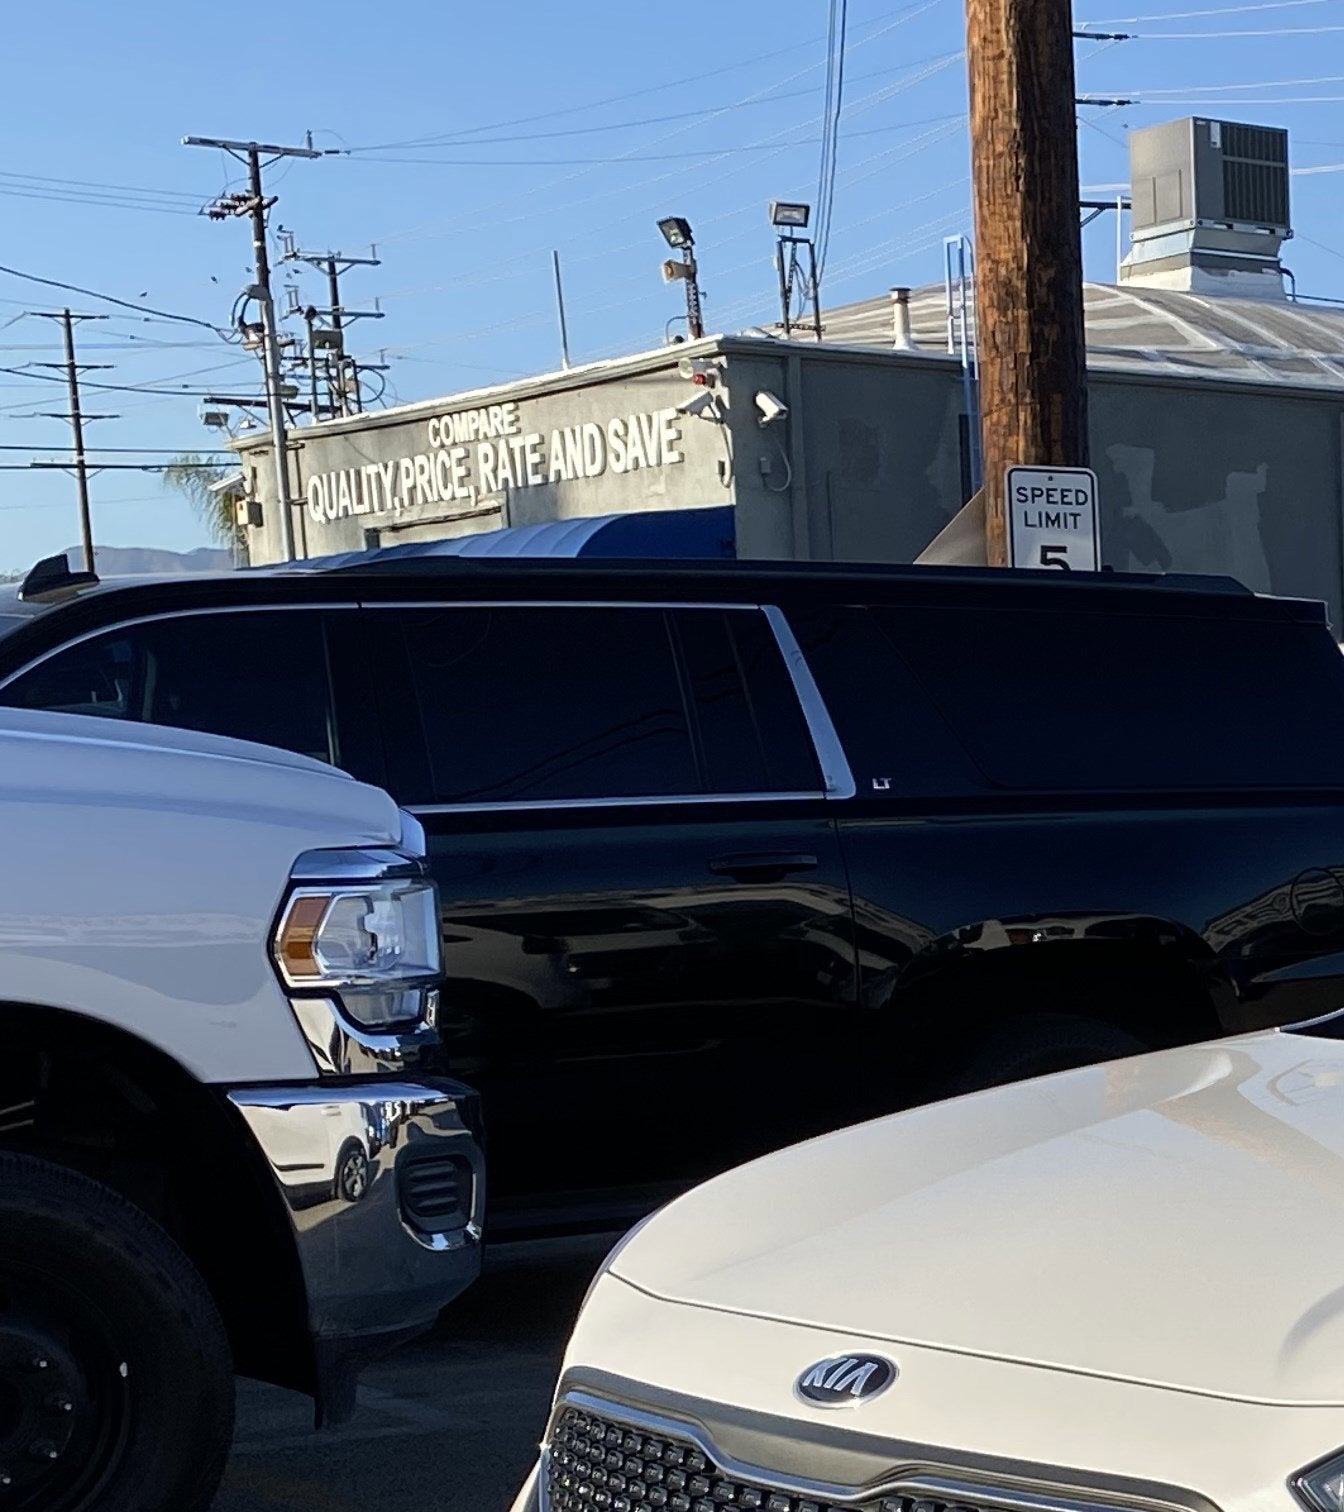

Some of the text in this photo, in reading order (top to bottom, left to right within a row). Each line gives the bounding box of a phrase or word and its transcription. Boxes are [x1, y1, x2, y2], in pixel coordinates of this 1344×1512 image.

[428, 402, 520, 448] COMPARE
[478, 432, 544, 496] RATE
[549, 422, 607, 483] AND
[607, 407, 684, 474] SAVE
[1016, 486, 1089, 506] SPEED
[1024, 510, 1082, 530] LIMIT
[1040, 545, 1072, 571] 5
[872, 777, 892, 789] LT
[801, 1357, 879, 1396] KIA
